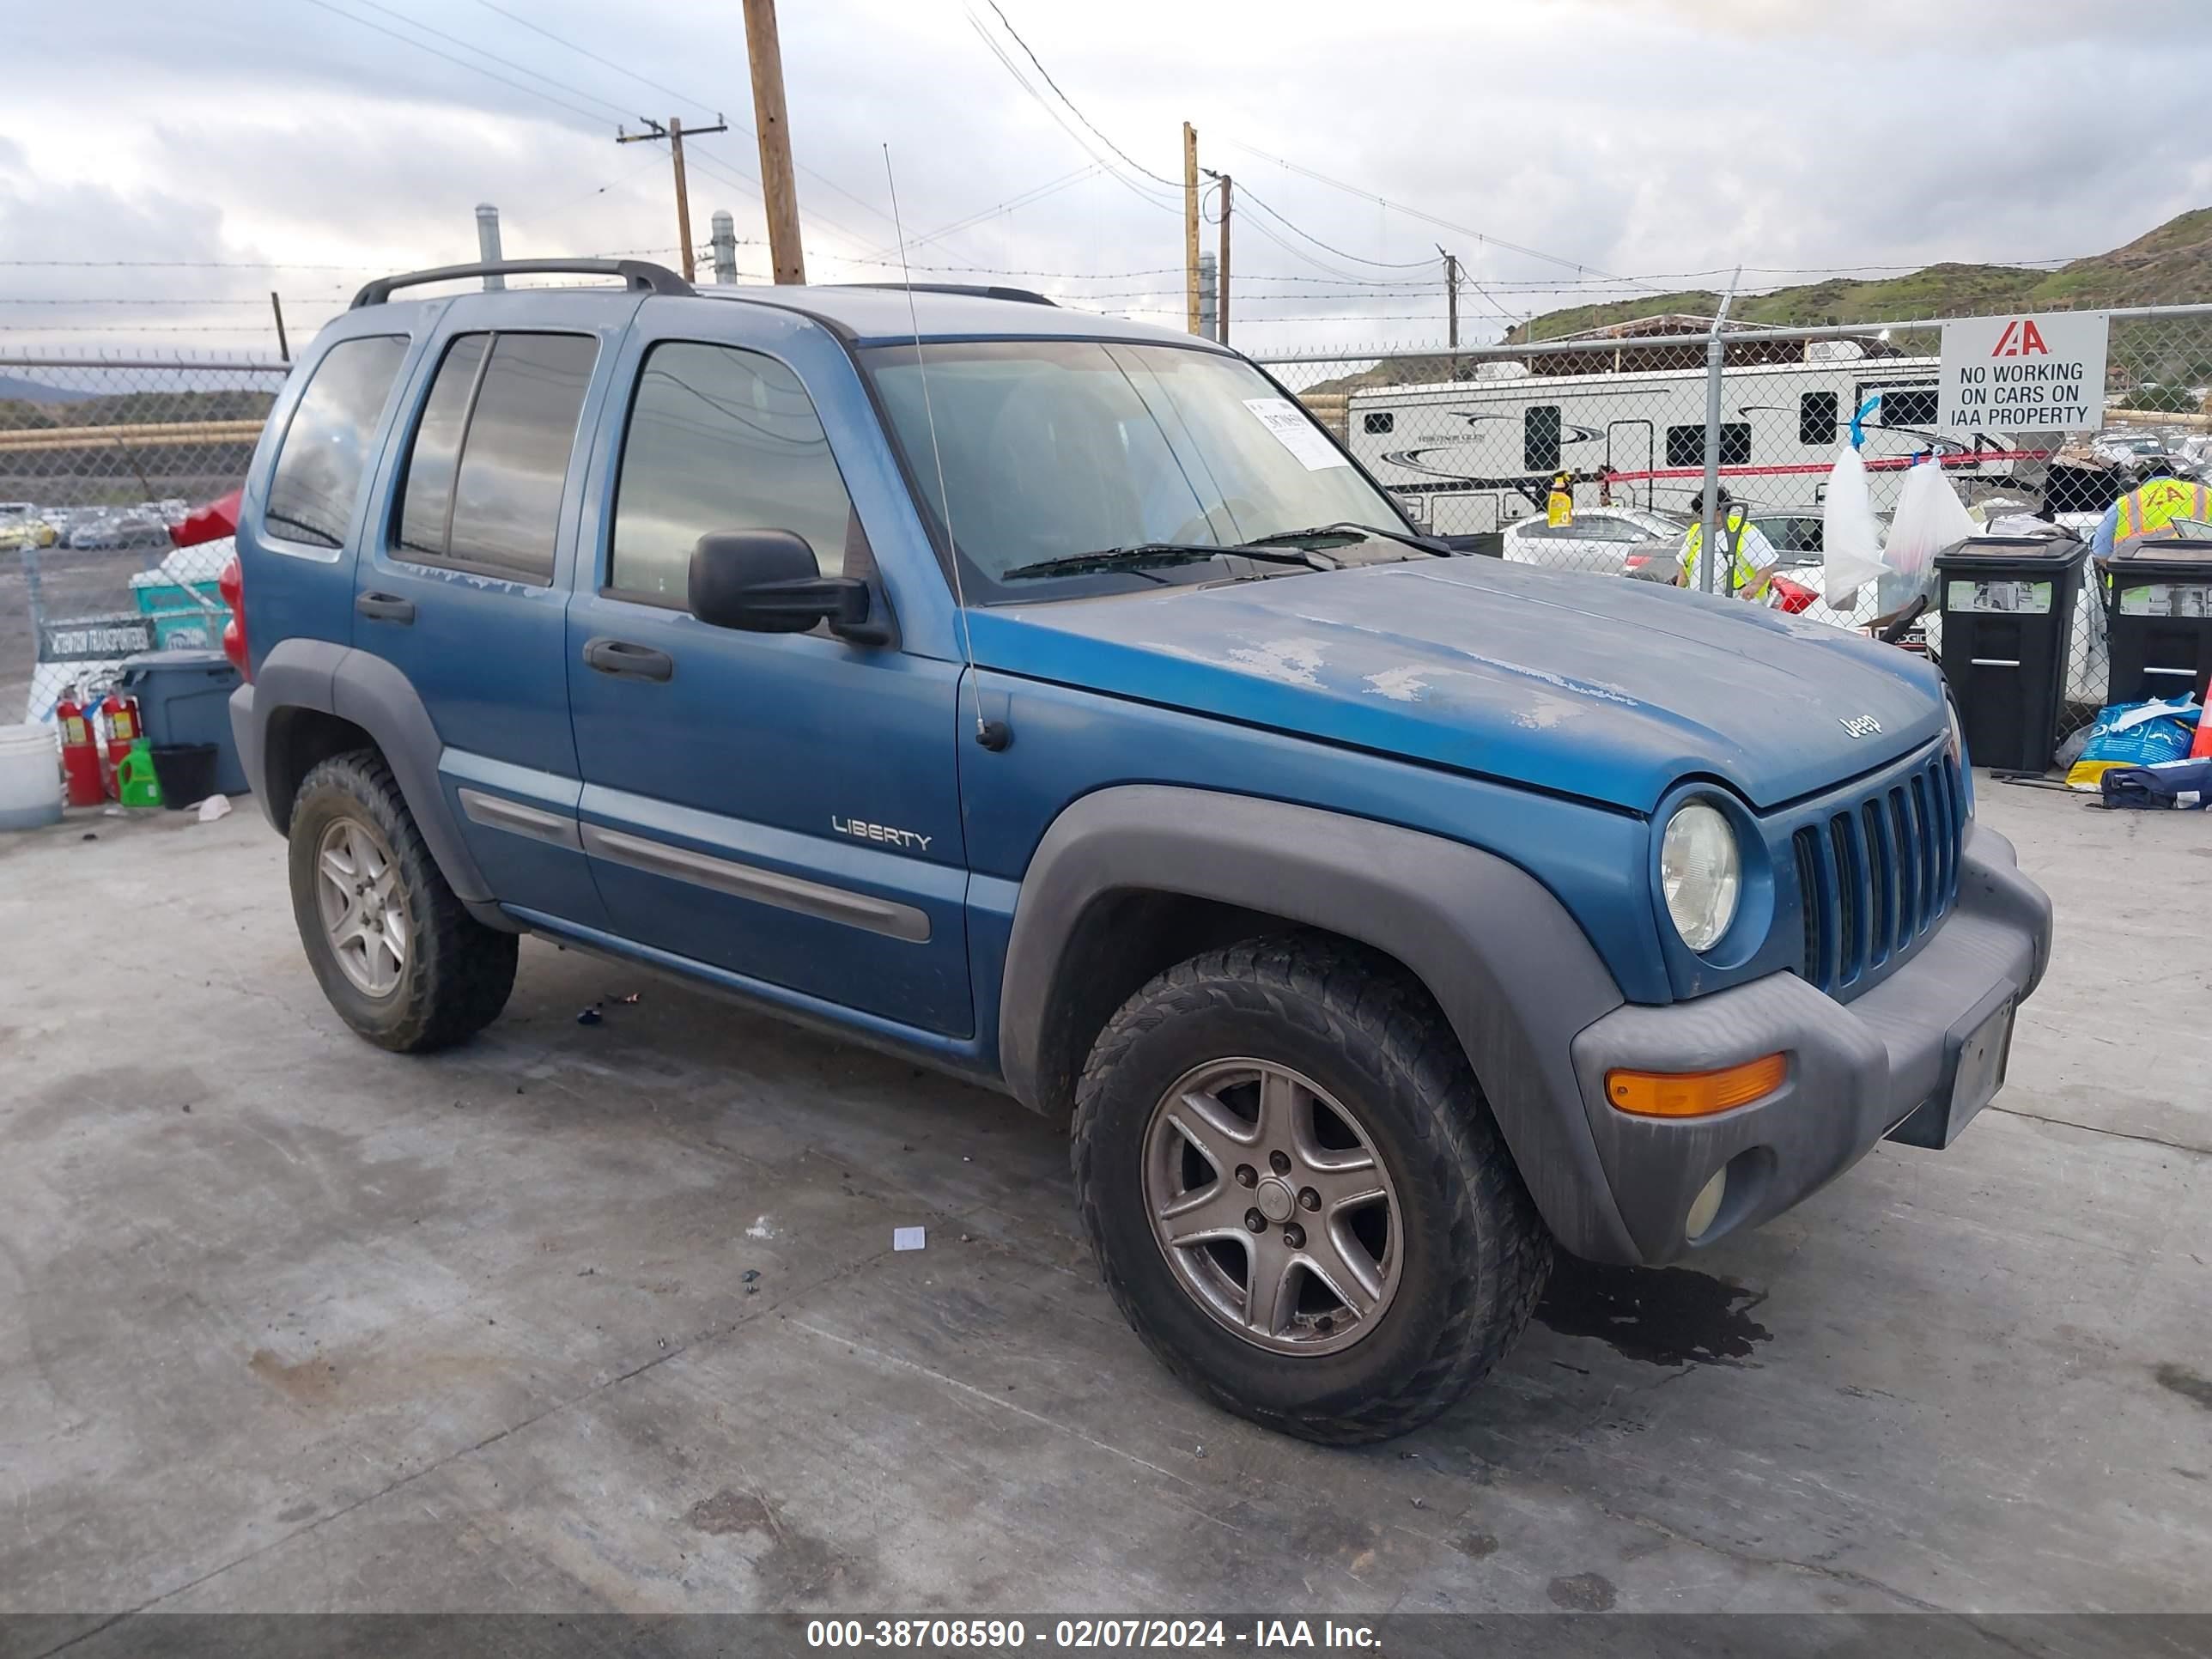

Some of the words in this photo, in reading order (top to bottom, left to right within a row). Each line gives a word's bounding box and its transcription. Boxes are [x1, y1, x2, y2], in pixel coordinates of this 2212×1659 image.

[1960, 366, 1986, 385] NO
[1993, 362, 2084, 383] WORKING
[1961, 387, 1987, 405] ON
[1994, 386, 2045, 404] CARS
[2052, 385, 2079, 403] ON
[1951, 409, 1982, 427] IAA
[1989, 405, 2088, 426] PROPERTY
[1838, 714, 1882, 739] Jeep
[831, 814, 933, 852] LIBERTY
